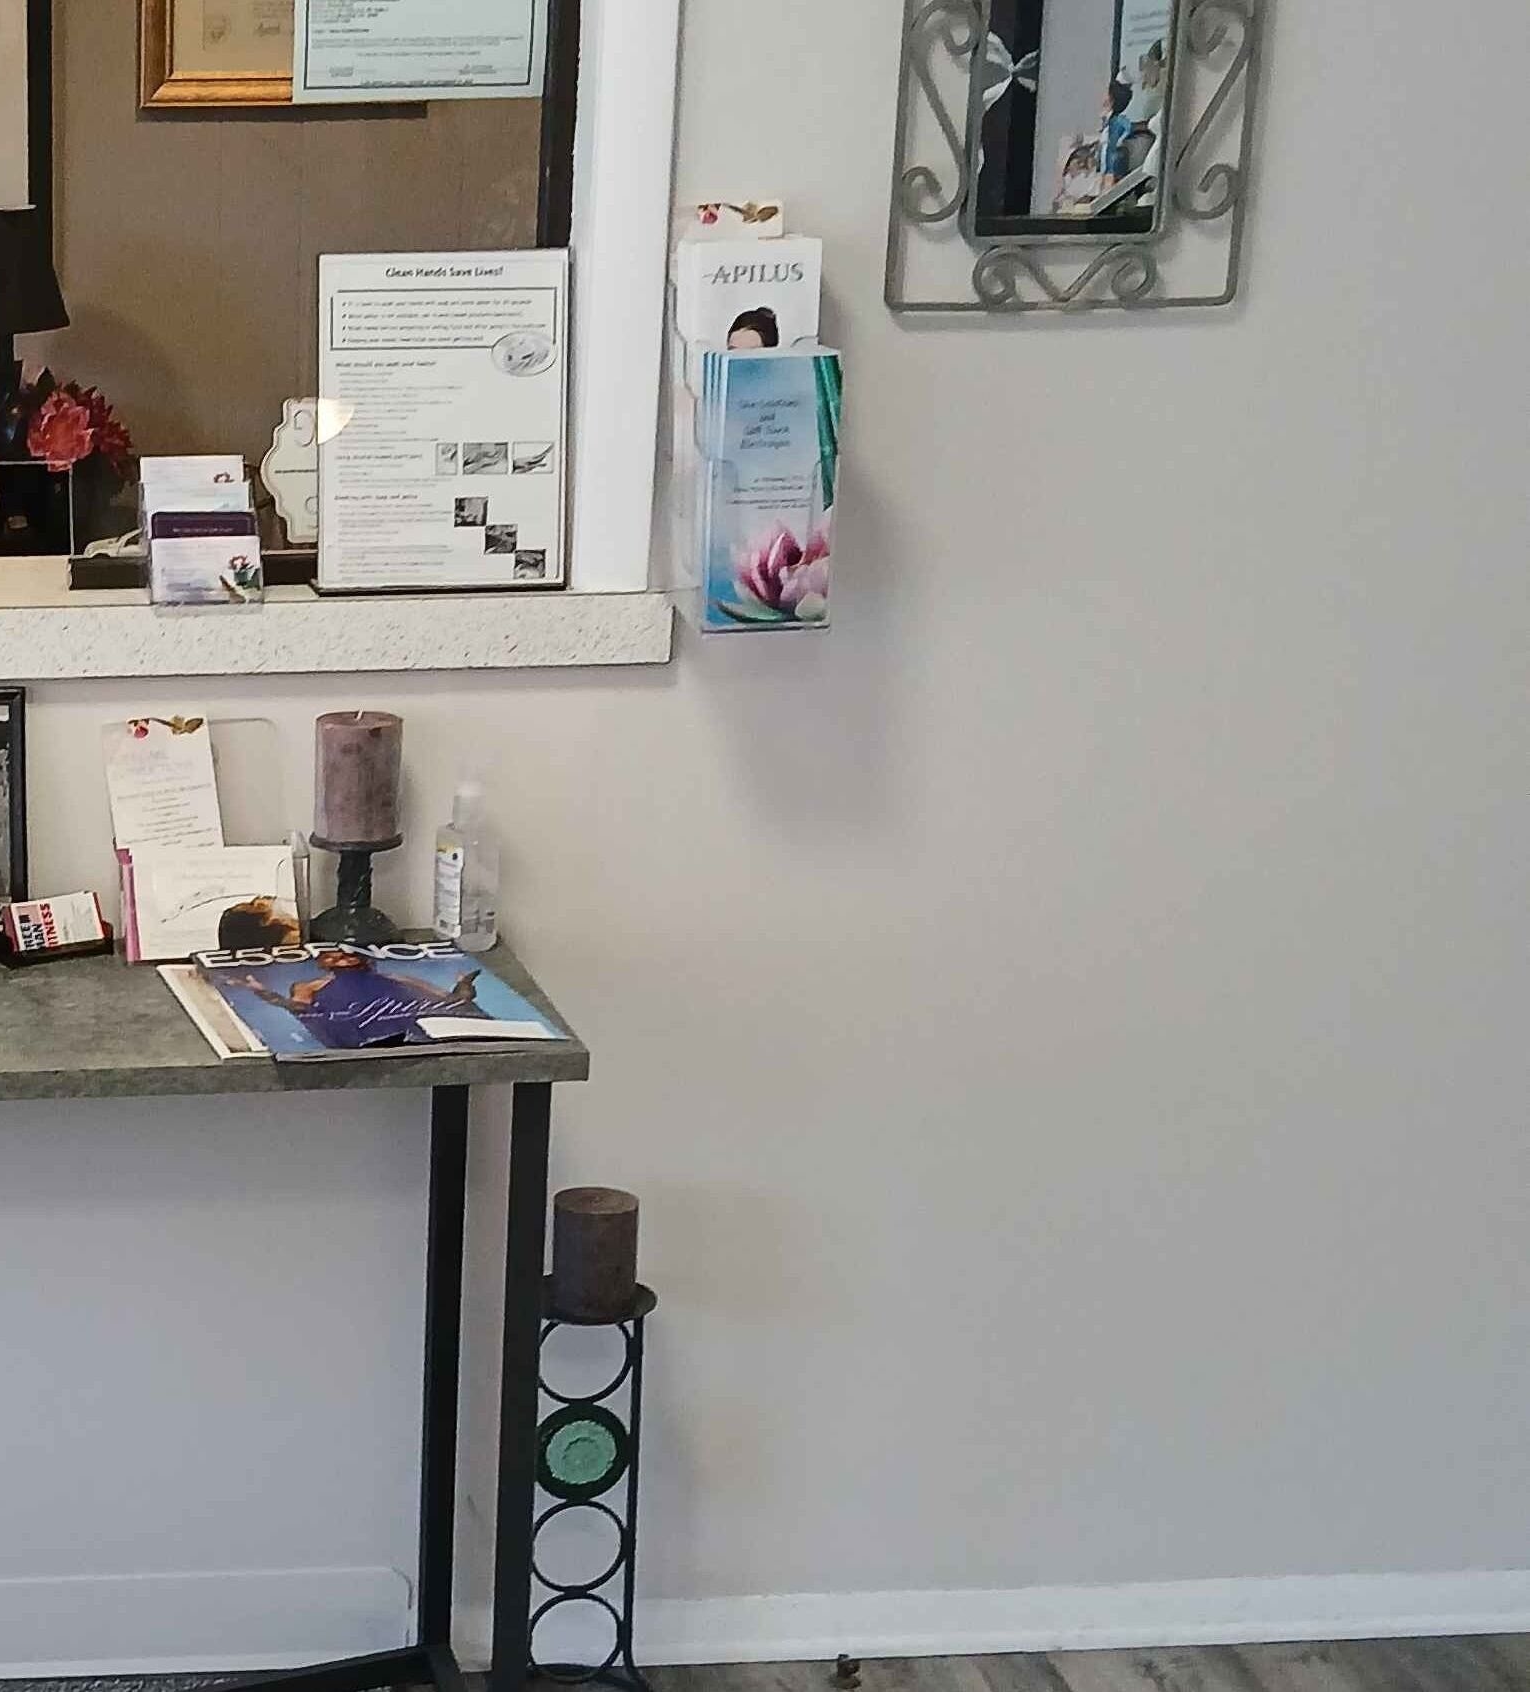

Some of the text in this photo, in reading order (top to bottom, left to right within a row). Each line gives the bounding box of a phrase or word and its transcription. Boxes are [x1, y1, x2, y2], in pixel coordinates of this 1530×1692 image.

[385, 265, 504, 279] Clean Hands Save Lives!
[701, 261, 804, 286] APILUS
[196, 938, 465, 969] ESSENCE
